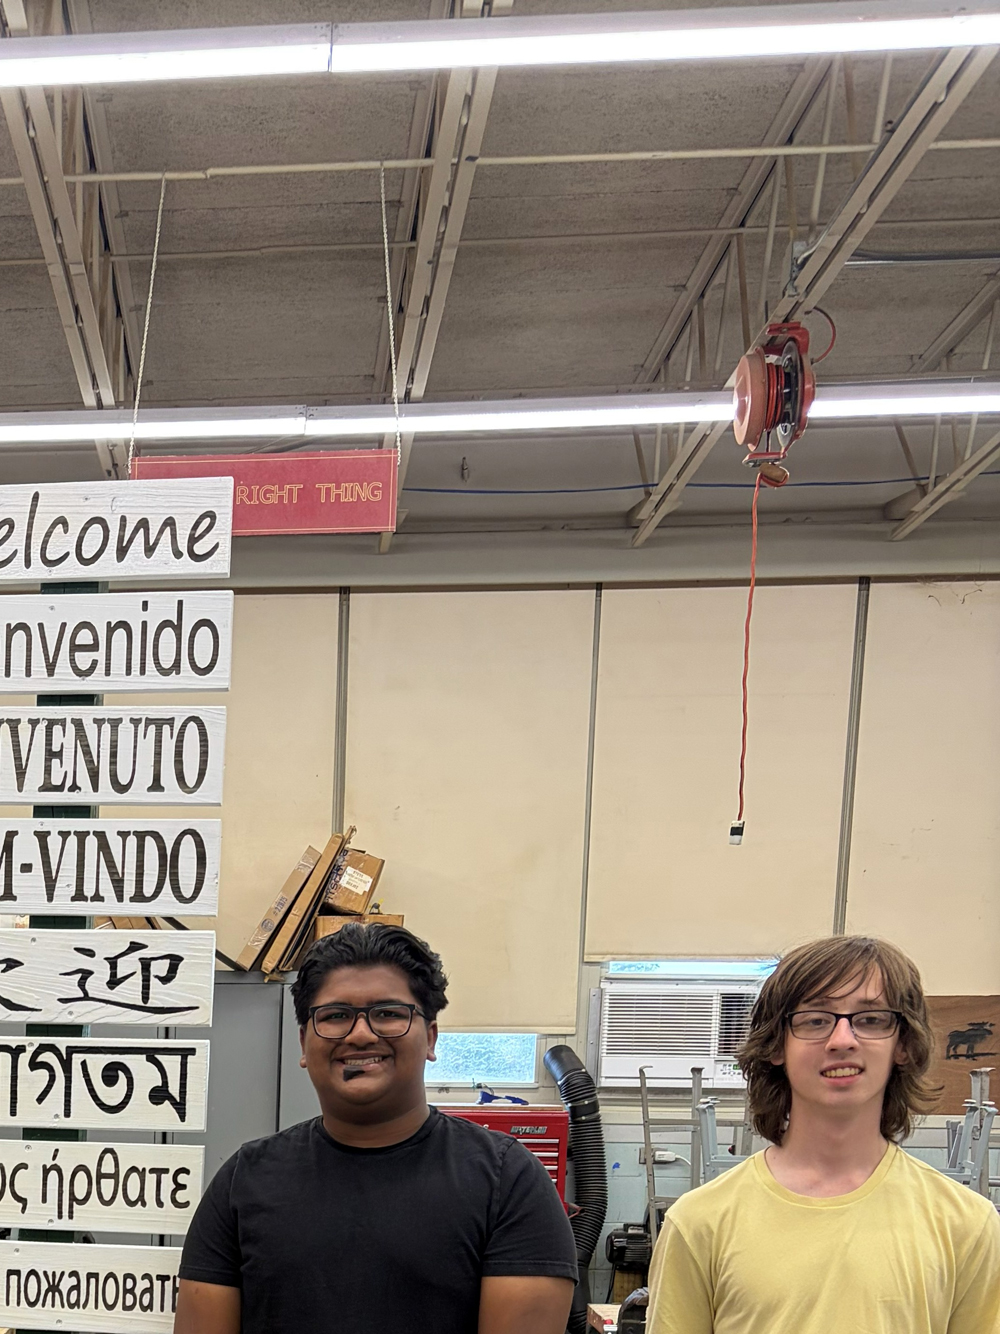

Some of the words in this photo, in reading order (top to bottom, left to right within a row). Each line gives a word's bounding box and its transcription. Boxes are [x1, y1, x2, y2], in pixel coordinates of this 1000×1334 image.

[236, 484, 303, 505] RIGHT
[316, 482, 383, 502] THING
[41, 1147, 191, 1221] ήρθατε
